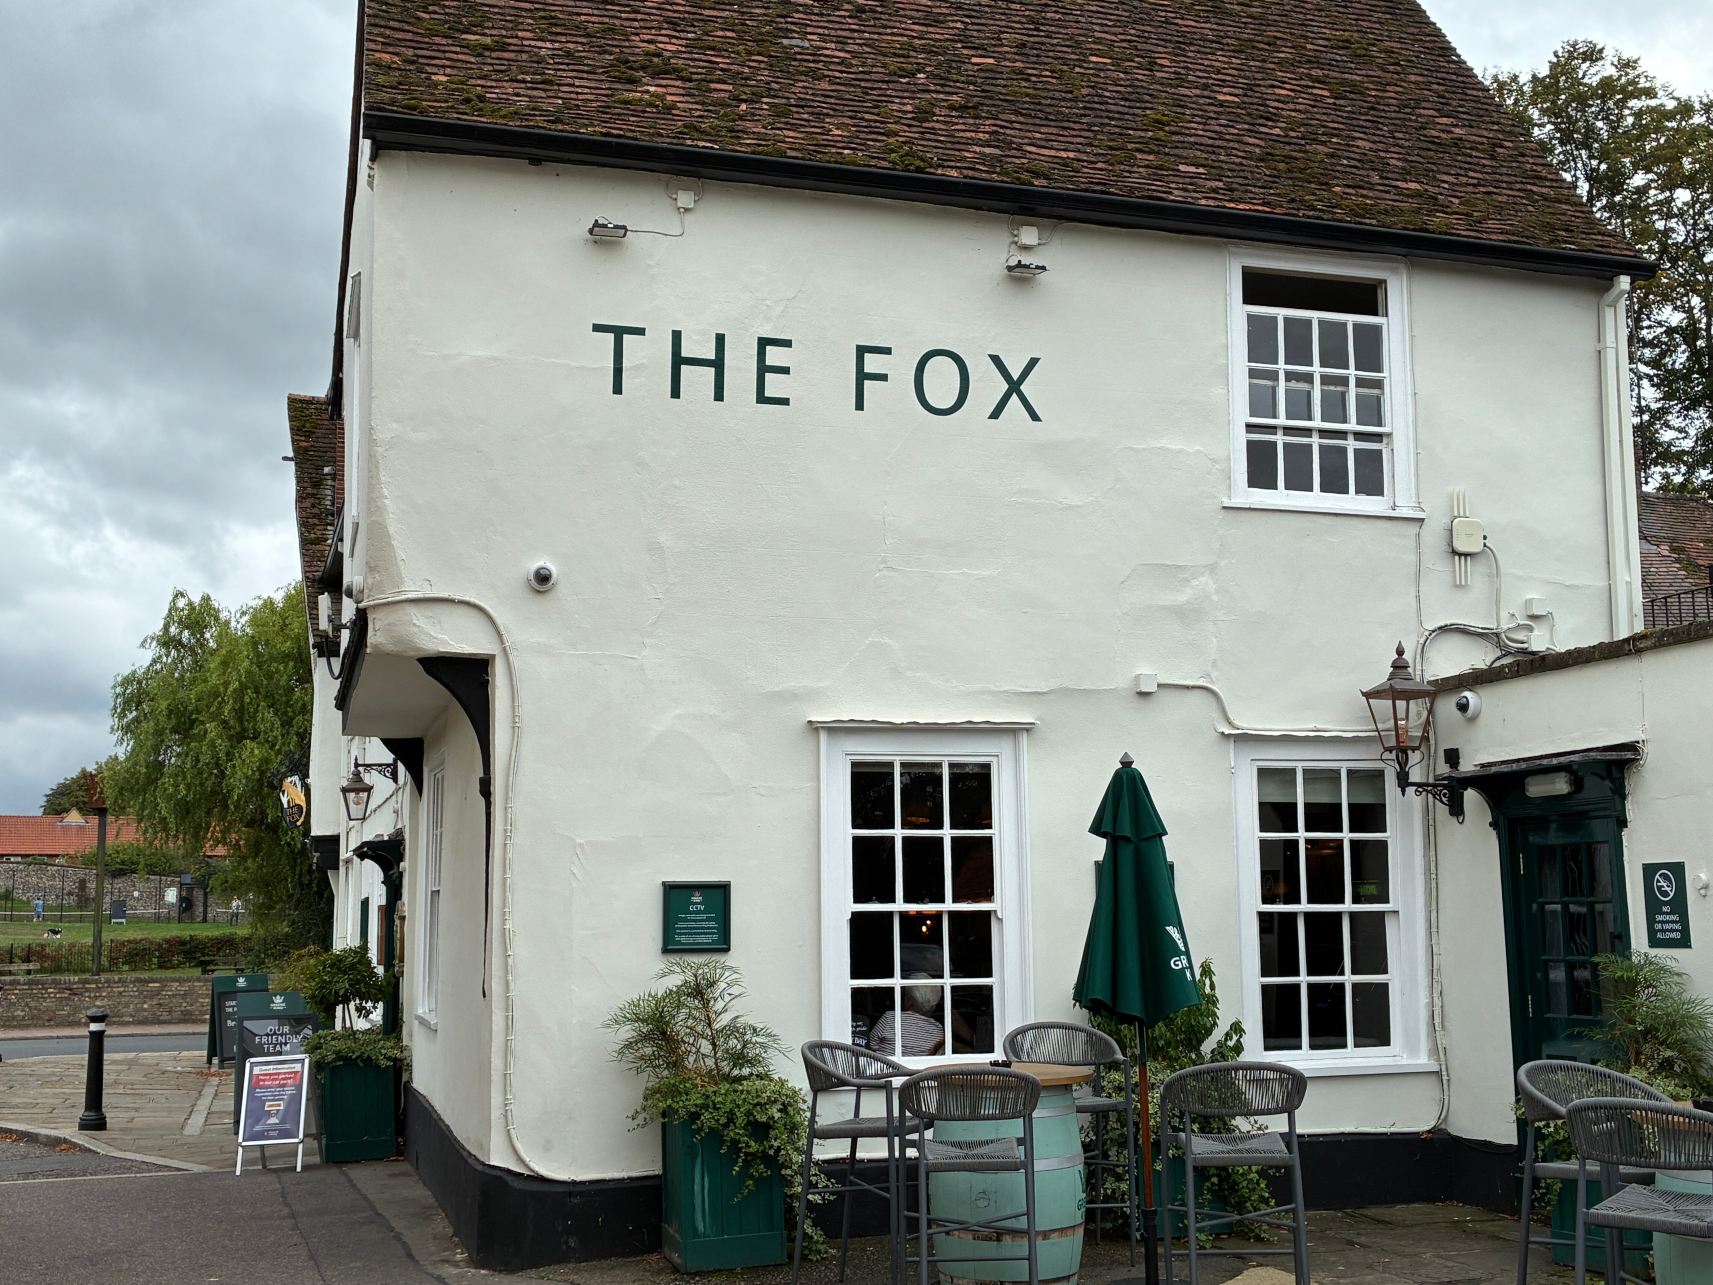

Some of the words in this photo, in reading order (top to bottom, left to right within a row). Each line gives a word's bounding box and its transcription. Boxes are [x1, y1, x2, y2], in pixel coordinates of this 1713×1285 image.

[592, 323, 793, 407] THE
[854, 344, 1043, 422] FOX
[286, 806, 299, 815] THE
[286, 814, 300, 822] FOX
[1656, 931, 1681, 939] ALLOWED
[267, 1025, 290, 1034] OUR
[255, 1034, 303, 1044] FRIENDLY
[263, 1043, 290, 1053] TEAM
